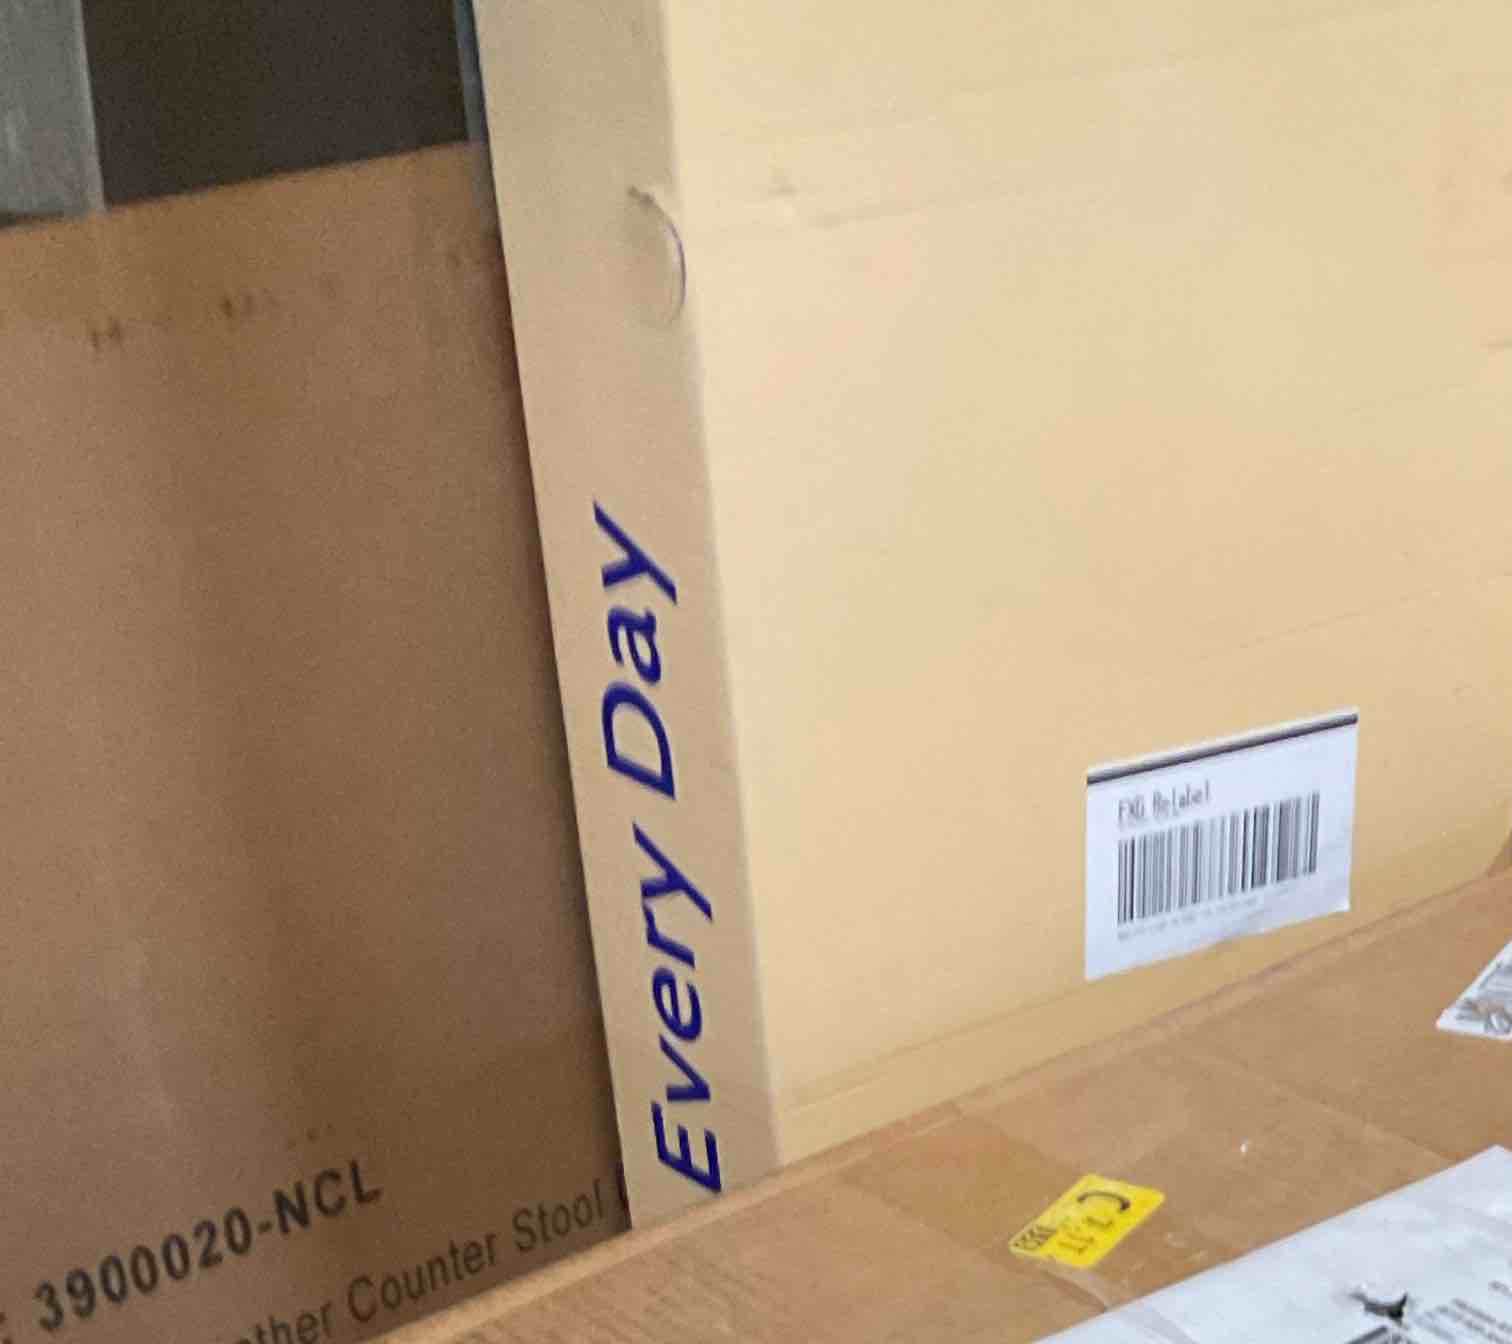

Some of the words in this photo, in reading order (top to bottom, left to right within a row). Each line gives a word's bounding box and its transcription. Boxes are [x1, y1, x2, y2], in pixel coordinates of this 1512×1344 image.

[593, 500, 678, 799] Day
[633, 821, 722, 1193] Every
[35, 1160, 383, 1333] 3900020-NCL
[347, 1229, 499, 1323] Counter
[512, 1178, 603, 1254] Stool
